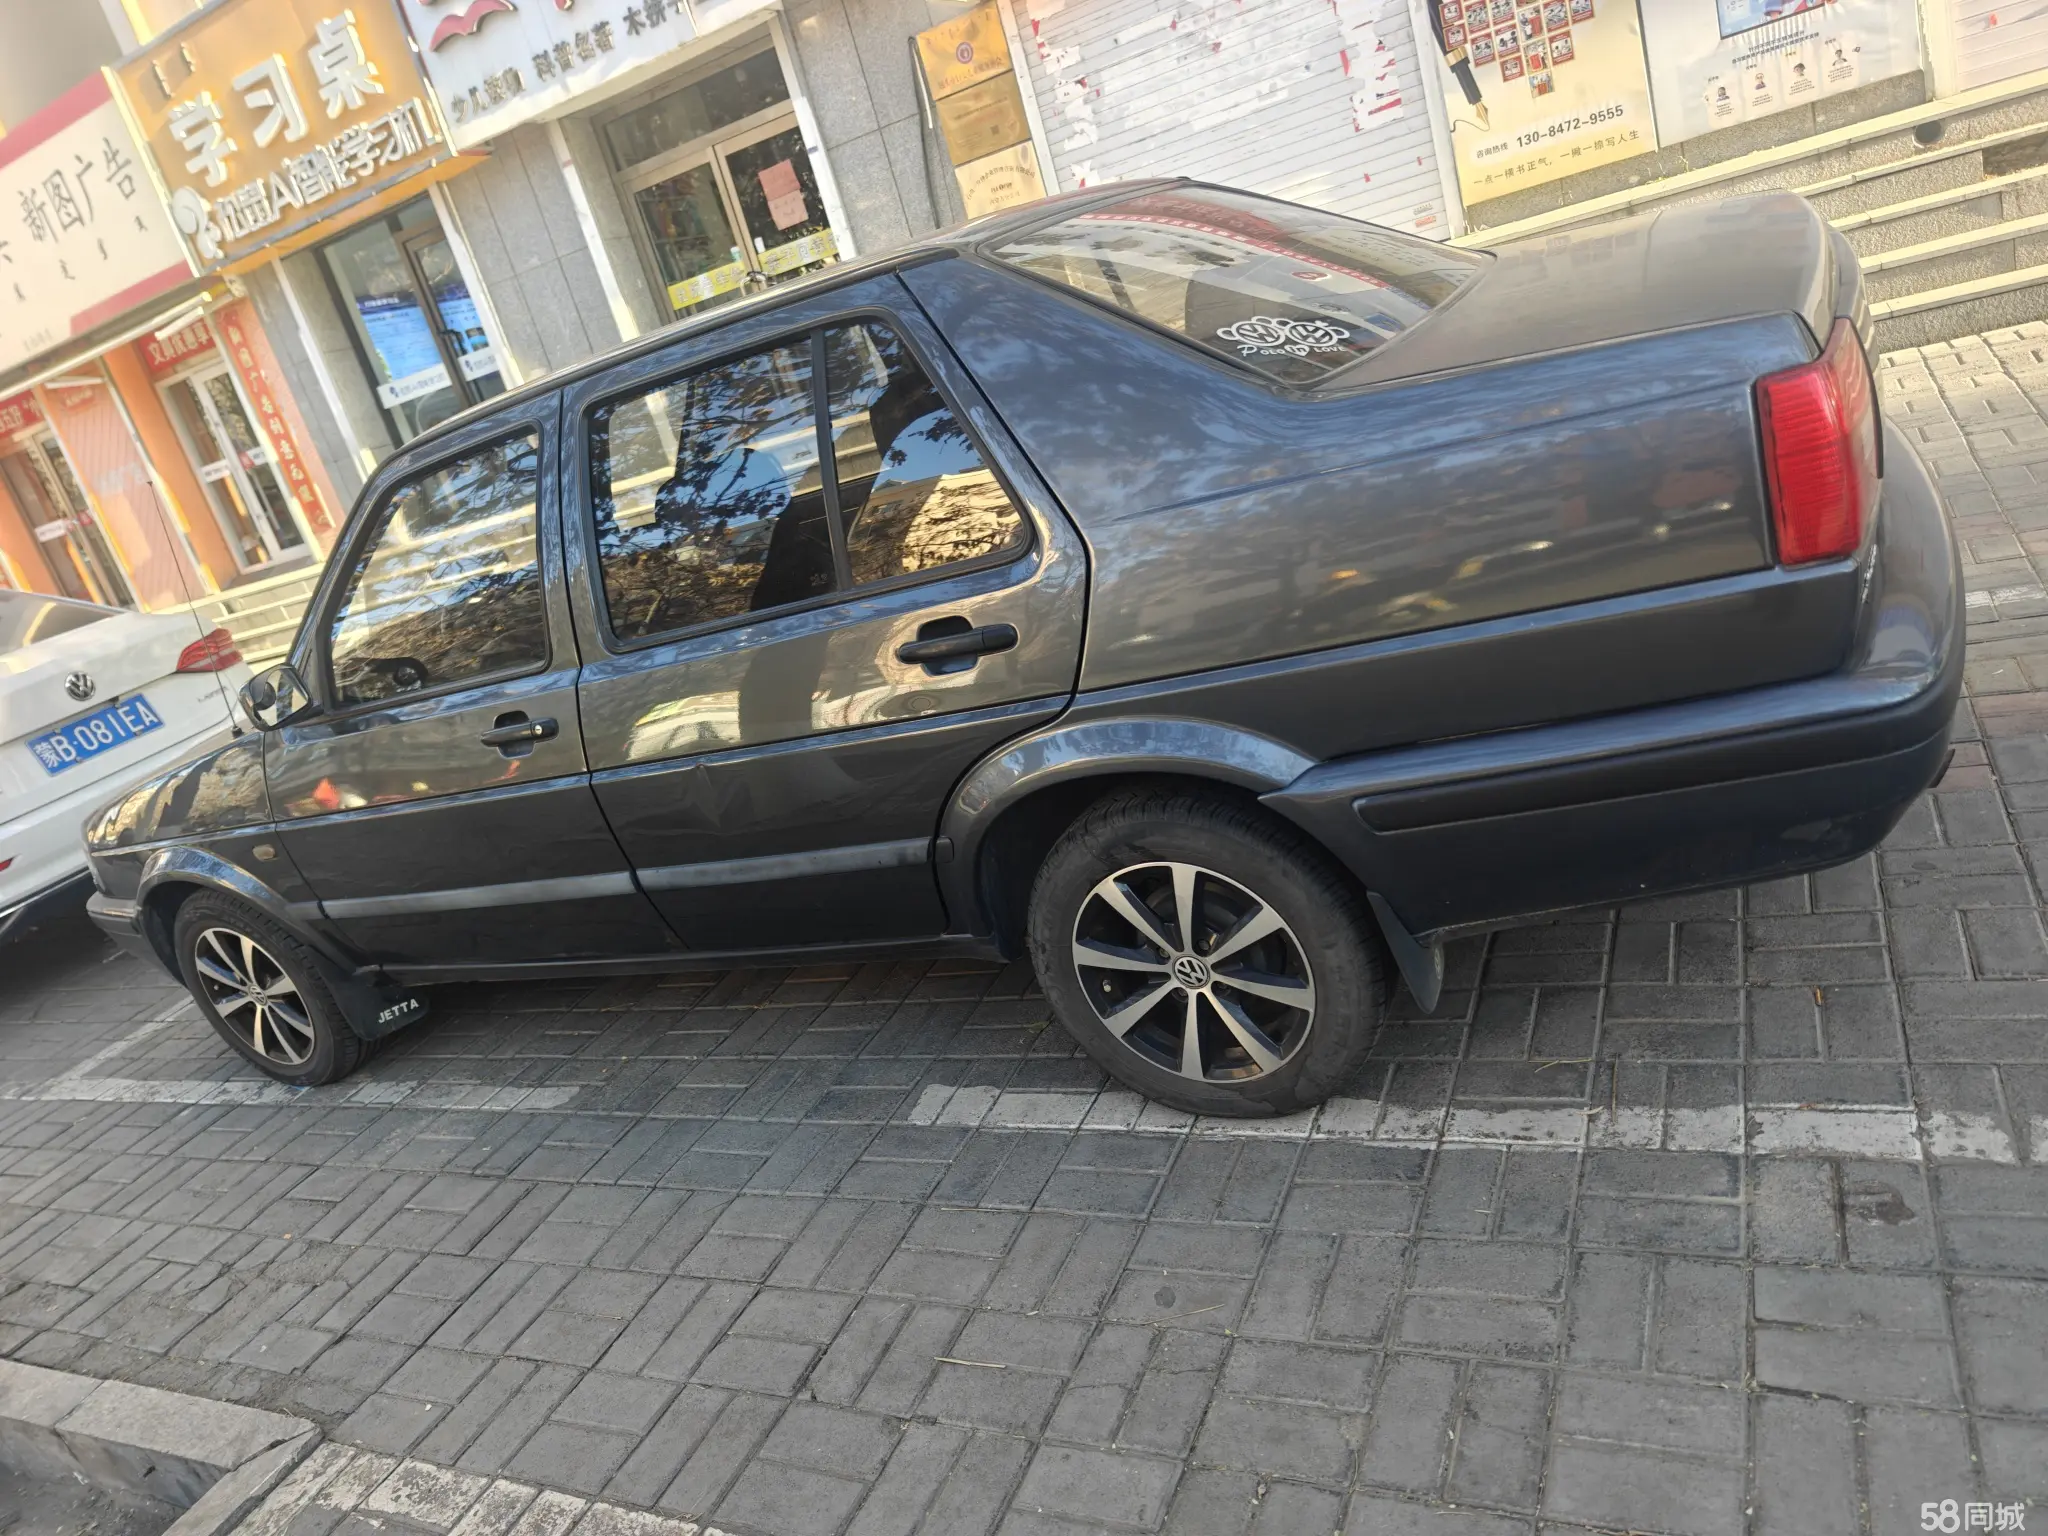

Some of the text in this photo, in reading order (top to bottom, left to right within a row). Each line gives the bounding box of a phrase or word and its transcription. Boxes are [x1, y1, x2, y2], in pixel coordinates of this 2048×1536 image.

[168, 9, 384, 187] 学习桌
[1476, 103, 1625, 159] 咨询热线 130-8472-9555
[17, 136, 132, 243] 新图广告
[377, 998, 419, 1025] JETTA
